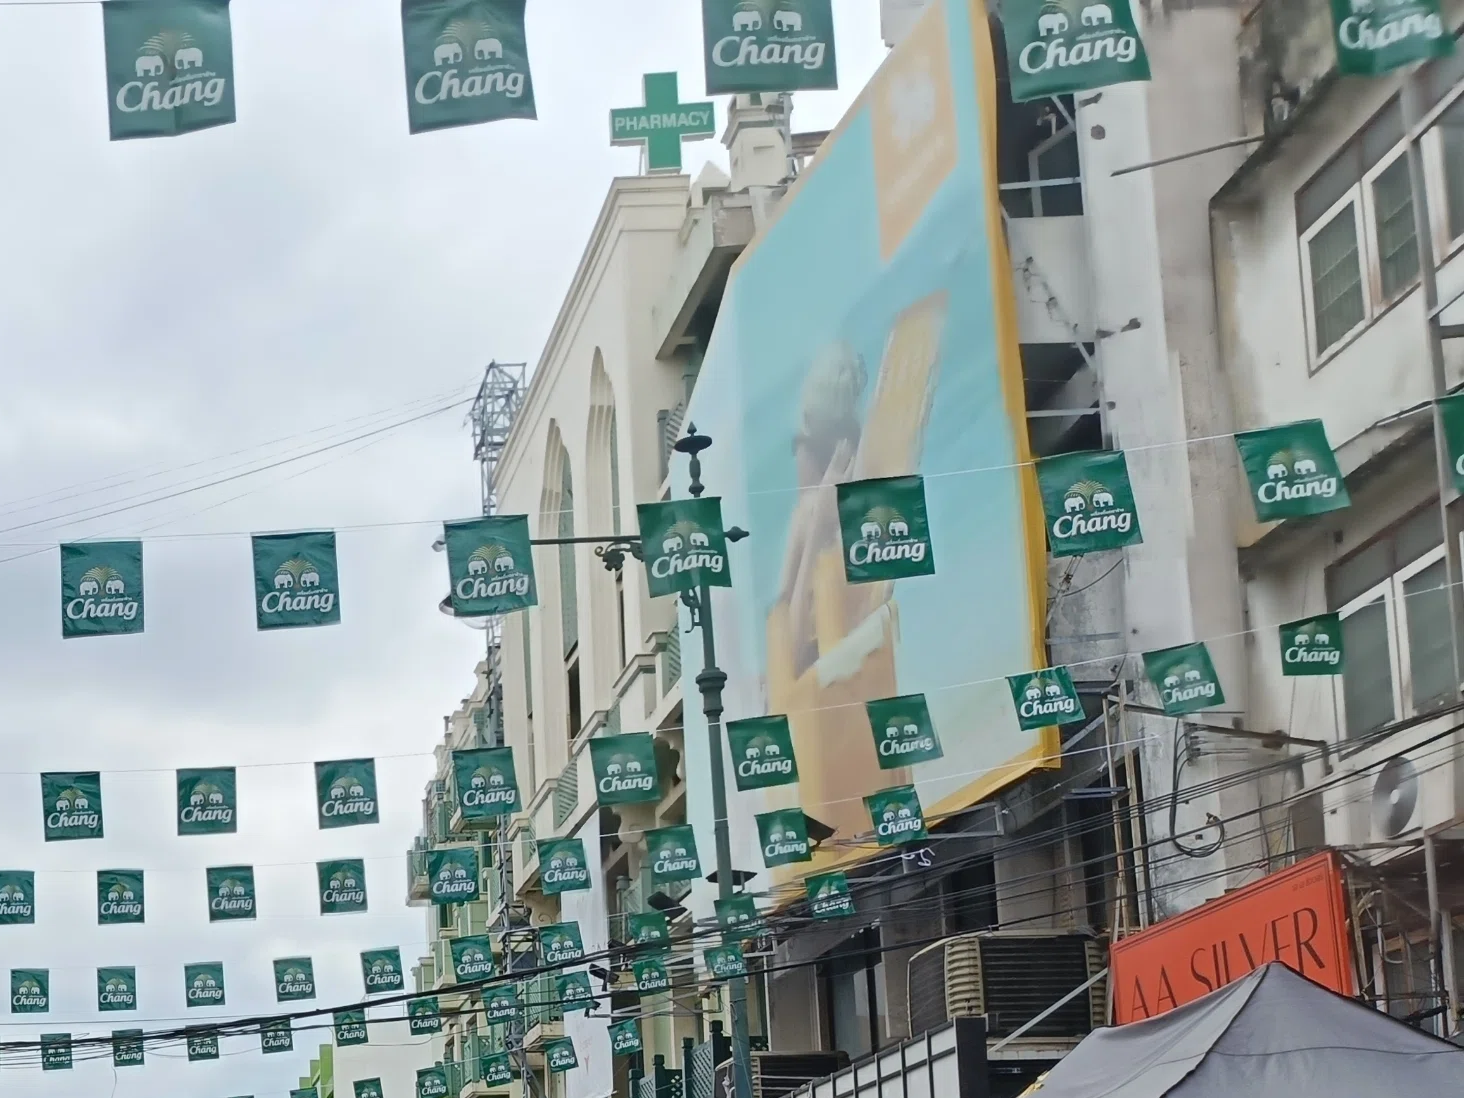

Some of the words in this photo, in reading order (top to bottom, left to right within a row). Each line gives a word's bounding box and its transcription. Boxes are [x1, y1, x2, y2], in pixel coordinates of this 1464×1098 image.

[1339, 7, 1441, 50] Chang
[712, 36, 825, 69] Chang
[1019, 30, 1136, 73] Chang
[415, 64, 524, 104] Chang
[116, 79, 225, 112] Chang
[614, 110, 711, 132] PHARMACY
[1258, 474, 1336, 503] Chang
[1053, 509, 1131, 538] Chang
[850, 533, 925, 564] Chang
[652, 554, 723, 578] Chang
[457, 572, 529, 599] Chang
[67, 597, 138, 619] Chang
[262, 589, 334, 612] Chang
[1285, 647, 1340, 664] Chang
[1162, 681, 1215, 704] Chang
[1020, 696, 1074, 717] Chang
[880, 735, 934, 755] Chang
[739, 759, 791, 776] Chang
[600, 775, 652, 792] Chang
[463, 787, 516, 806] Chang
[181, 806, 232, 822] Chang
[322, 798, 374, 816] Chang
[48, 811, 98, 828] Chang
[878, 817, 921, 835] Chang
[765, 842, 806, 857] Chang
[654, 858, 696, 873] Chang
[544, 868, 587, 883] Chang
[433, 879, 475, 894] Chang
[212, 897, 252, 910] Chang
[323, 889, 364, 902] Chang
[101, 902, 141, 915] Chang
[546, 947, 583, 963] Chang
[457, 962, 491, 975] Chang
[1130, 963, 1178, 1023] AA
[1190, 907, 1325, 993] SILVER
[279, 982, 312, 993] Chang
[367, 974, 400, 985] Chang
[13, 995, 46, 1006] Chang
[100, 993, 133, 1003] Chang
[189, 988, 222, 999] Chang
[487, 1071, 510, 1081] Chang
[422, 1086, 446, 1095] Chang
